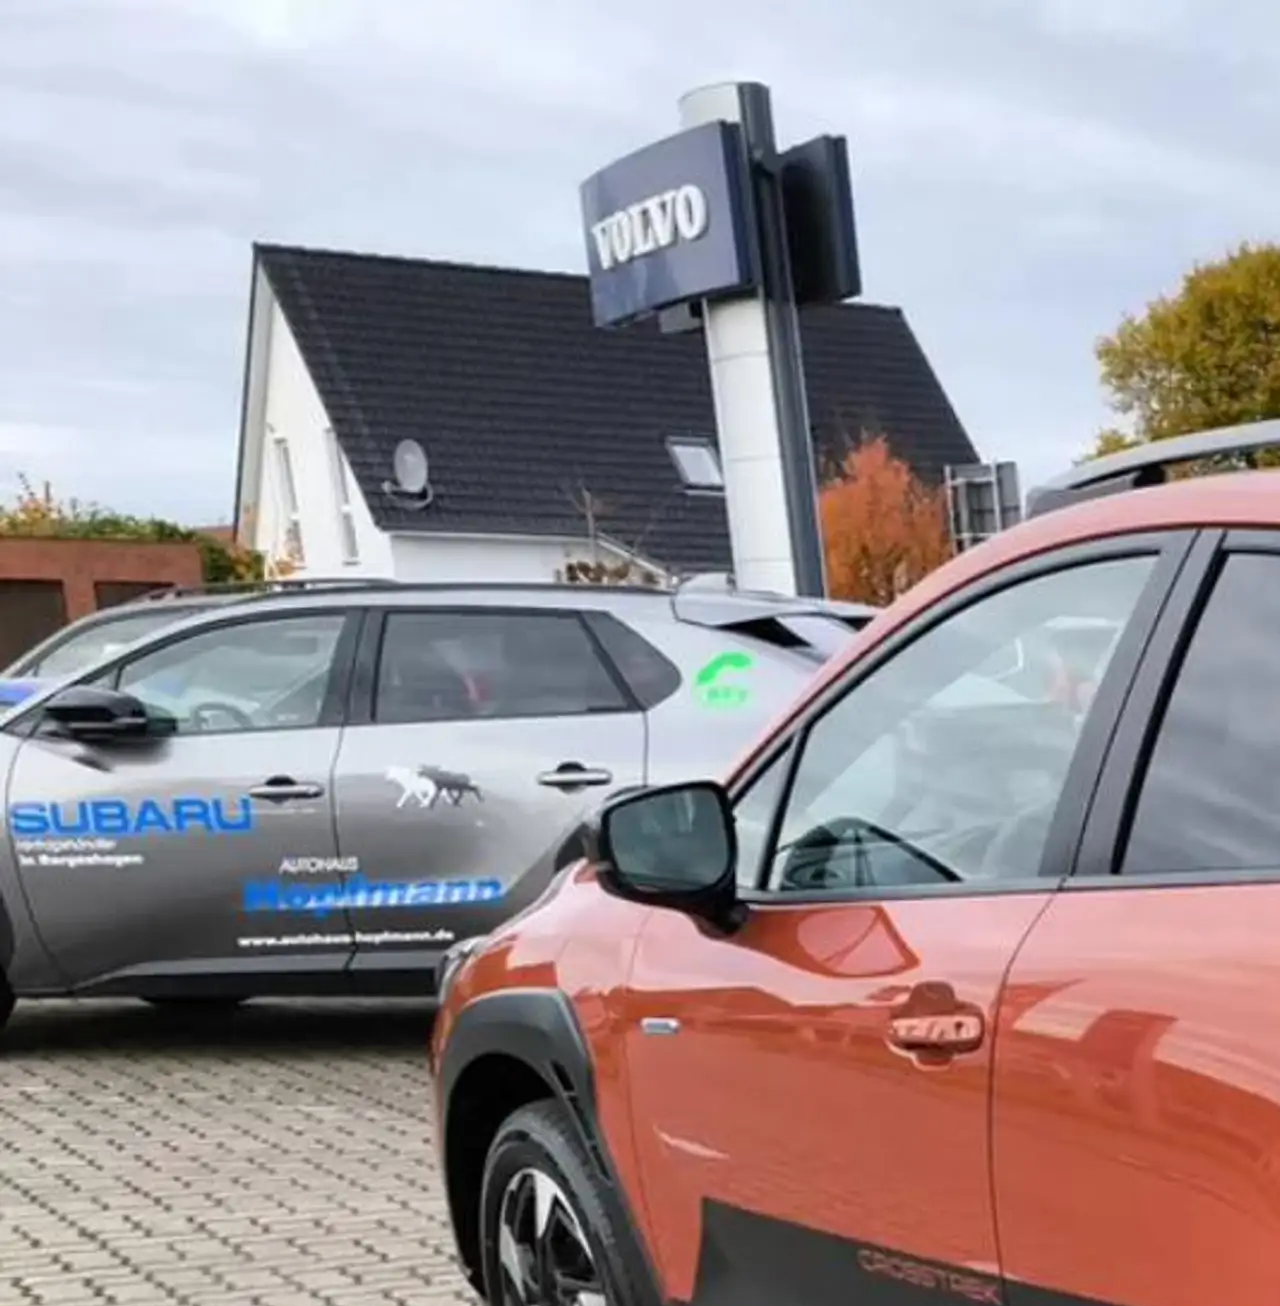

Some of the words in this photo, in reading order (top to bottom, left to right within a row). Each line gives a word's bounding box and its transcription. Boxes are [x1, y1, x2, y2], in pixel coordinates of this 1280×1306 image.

[592, 184, 707, 269] VOLVO
[10, 798, 253, 834] SUBARU
[279, 856, 358, 873] AUTOHAUS
[857, 1249, 1003, 1306] CROSSTREK
